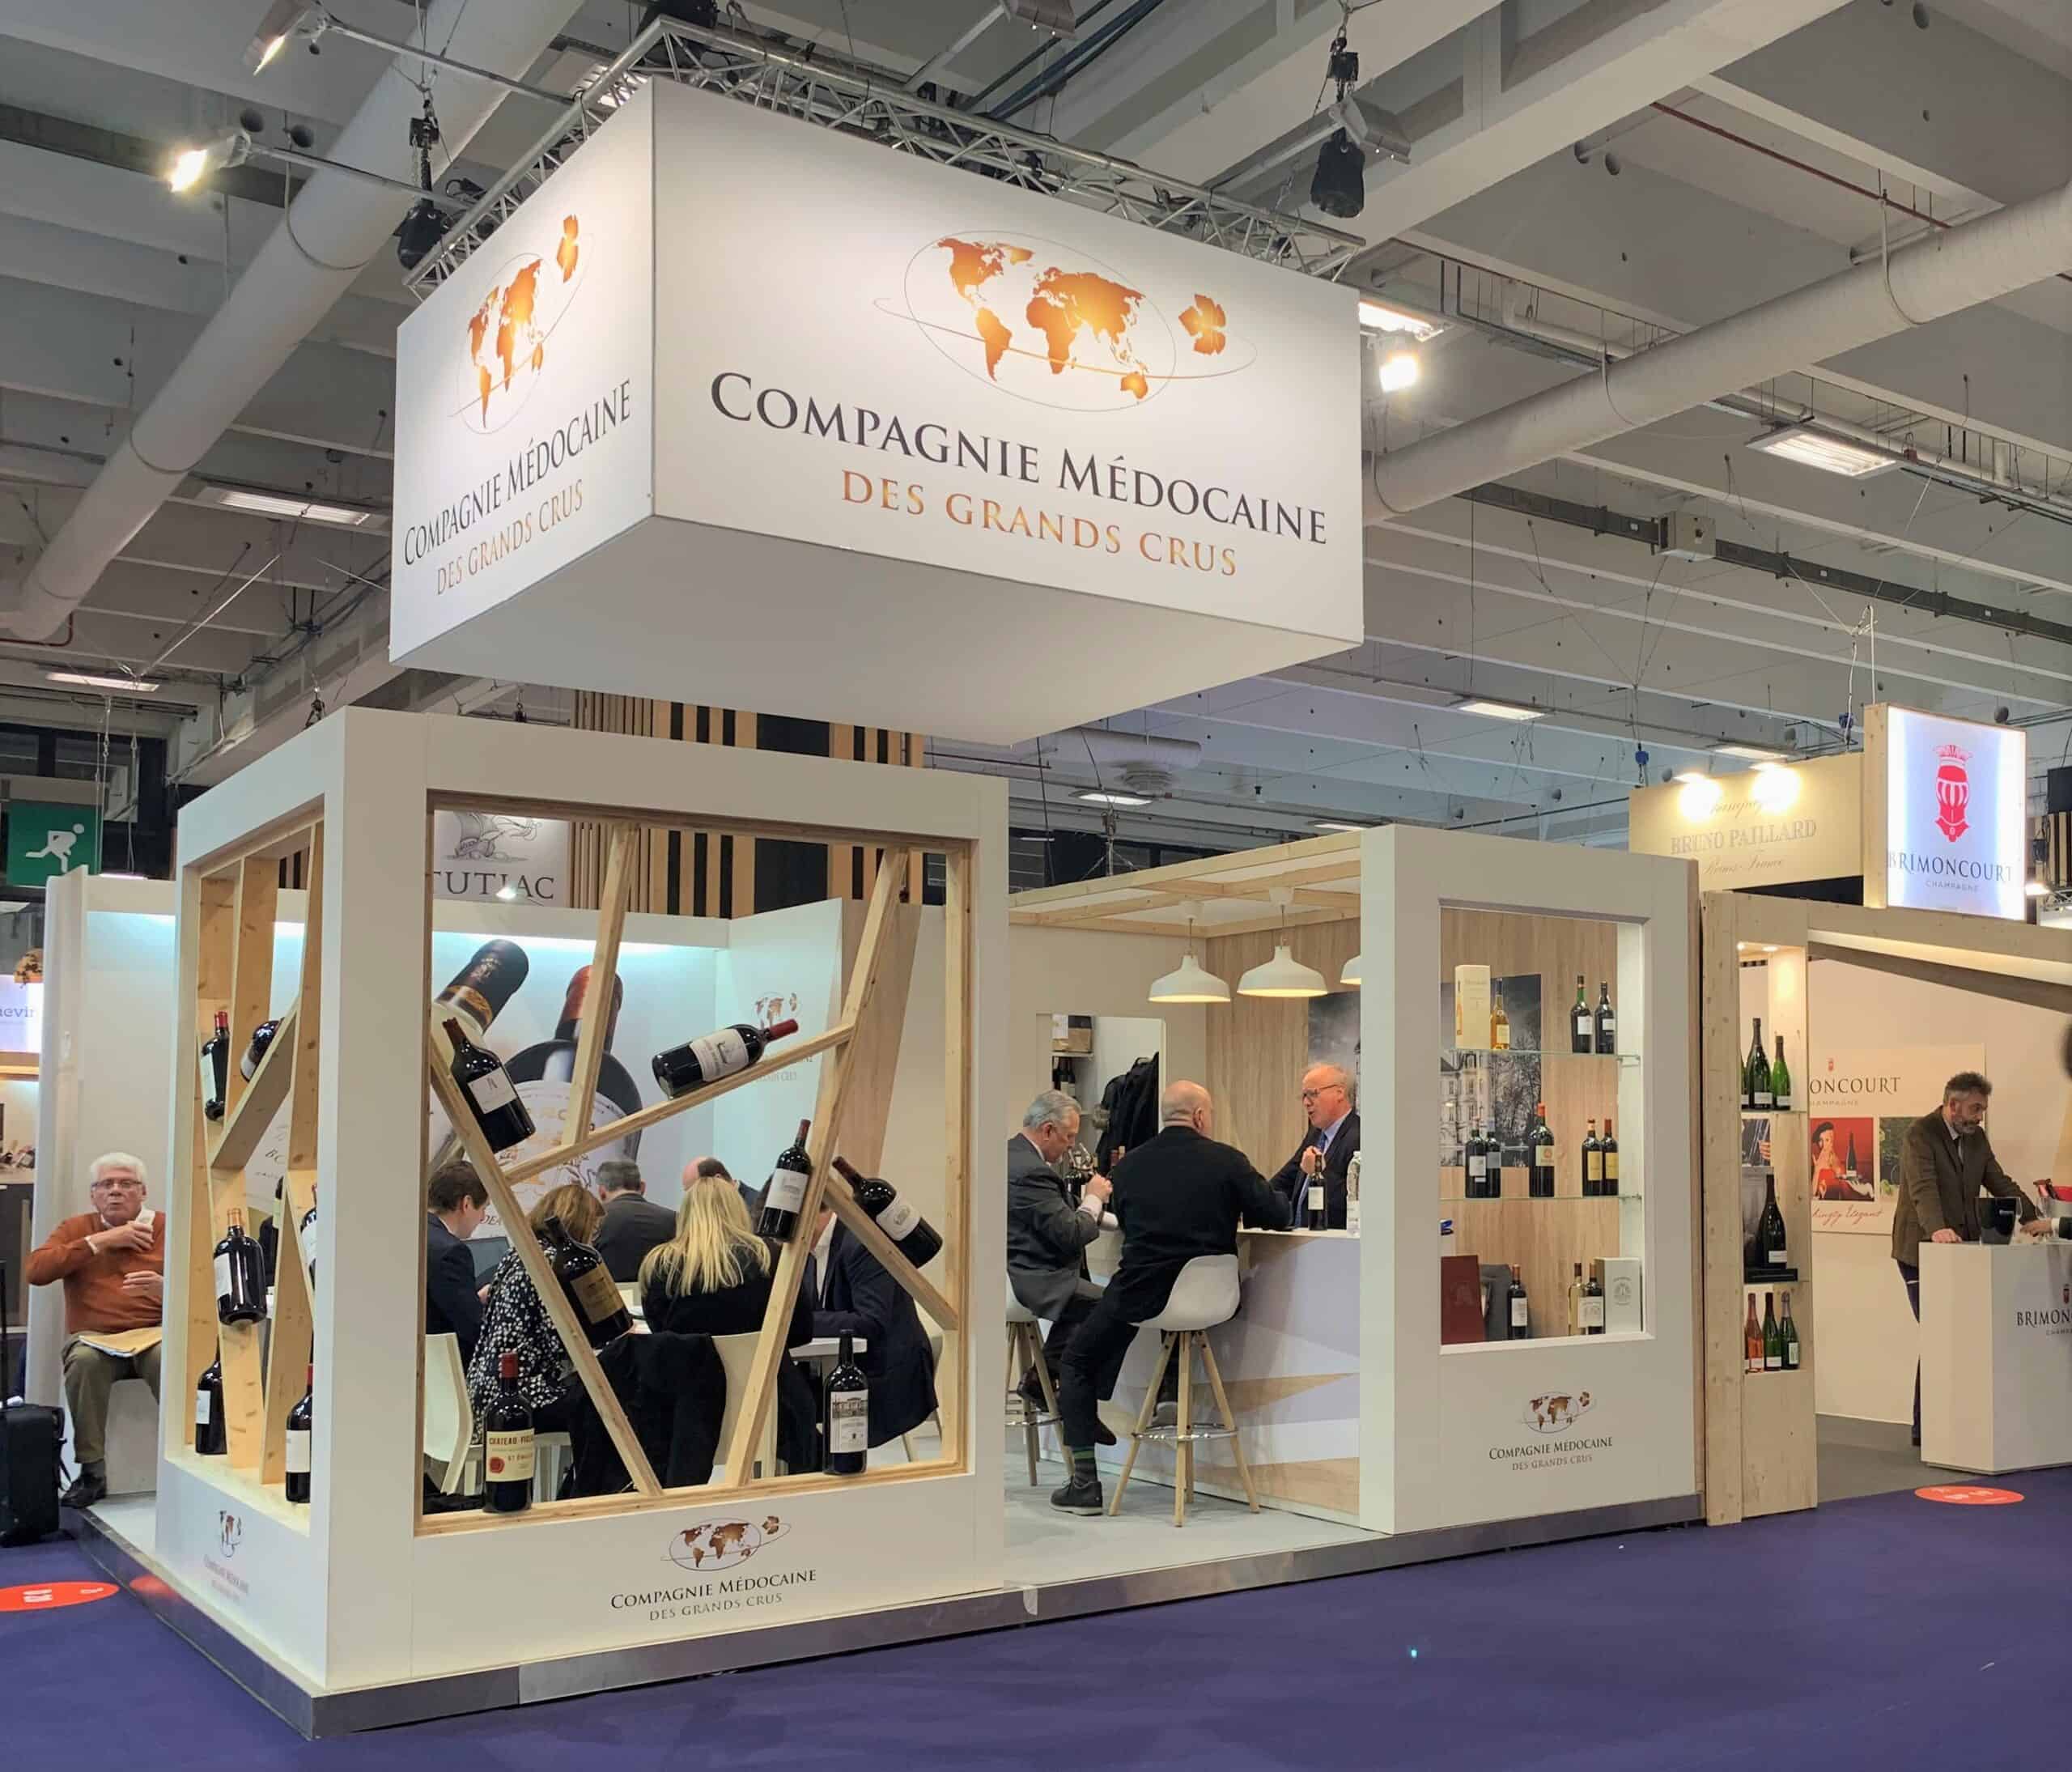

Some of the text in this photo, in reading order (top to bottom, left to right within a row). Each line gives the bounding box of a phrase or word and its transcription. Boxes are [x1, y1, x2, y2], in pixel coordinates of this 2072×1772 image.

[405, 378, 631, 565] COMPAGNIE MÉDOCAINE
[711, 372, 1327, 545] COMPAGNIE MÉDOCAINE
[437, 478, 583, 595] DES GRANDS CRUS
[842, 470, 1237, 576] DES GRANDS CRUS
[1670, 818, 1817, 855] BRUNO PAILLARD
[1887, 850, 2012, 882] BRIMONCOURT
[1488, 1443, 1551, 1460] COMPAGNIE
[1512, 1462, 1529, 1471] DES
[1531, 1456, 1568, 1469] GRANDS
[610, 1569, 817, 1609] COMPAGNIE MÉDOCAINE
[649, 1592, 783, 1621] DES GRANDS CRUS
